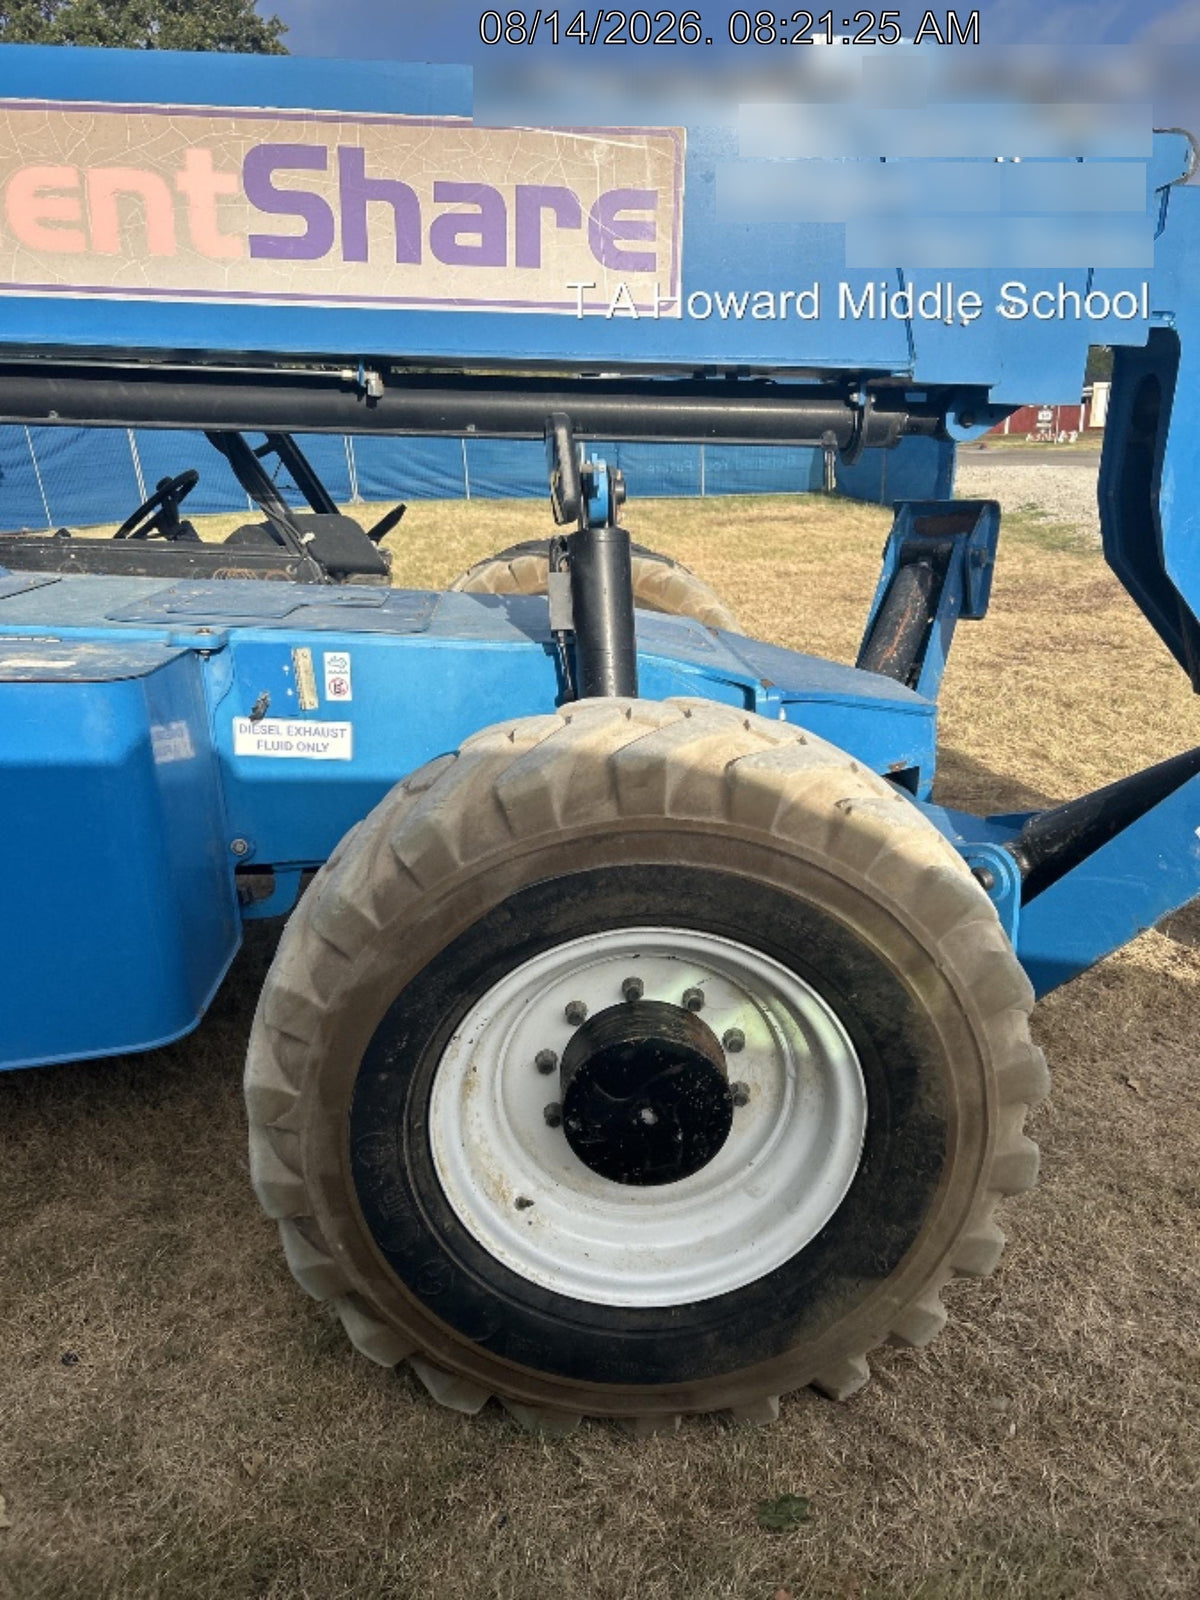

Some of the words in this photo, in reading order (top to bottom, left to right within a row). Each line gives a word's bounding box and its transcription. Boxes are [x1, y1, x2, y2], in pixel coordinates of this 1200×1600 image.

[239, 723, 282, 735] DIESEL
[287, 725, 347, 739] EXHAUST
[257, 740, 293, 751] FLUID
[296, 741, 330, 753] ONLY
